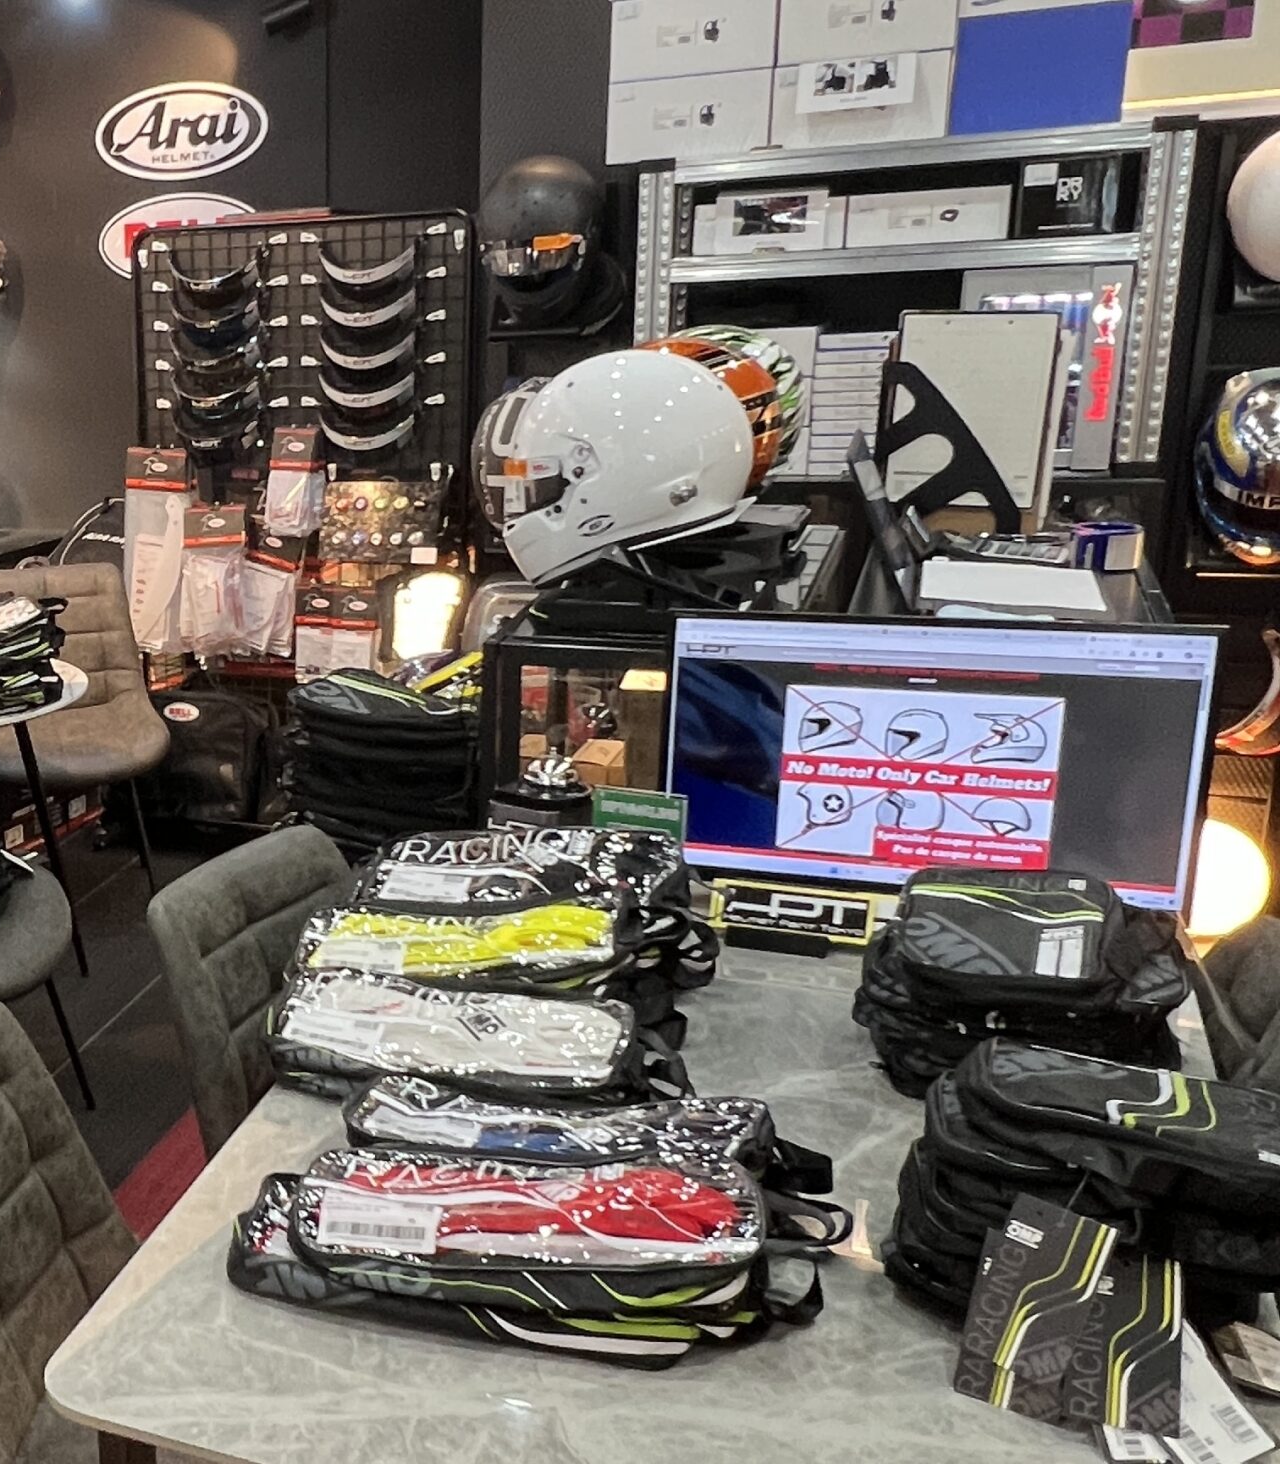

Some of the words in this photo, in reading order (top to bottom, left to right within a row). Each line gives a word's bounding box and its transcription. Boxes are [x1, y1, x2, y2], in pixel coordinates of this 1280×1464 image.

[112, 98, 241, 156] Arai
[151, 151, 210, 164] HELMET
[168, 707, 193, 718] BELL
[786, 761, 815, 776] No
[817, 764, 872, 780] Moto!
[876, 766, 921, 786] Only
[924, 770, 959, 786] Car
[961, 774, 1051, 793] Helmets!
[966, 1243, 1026, 1350] RACING
